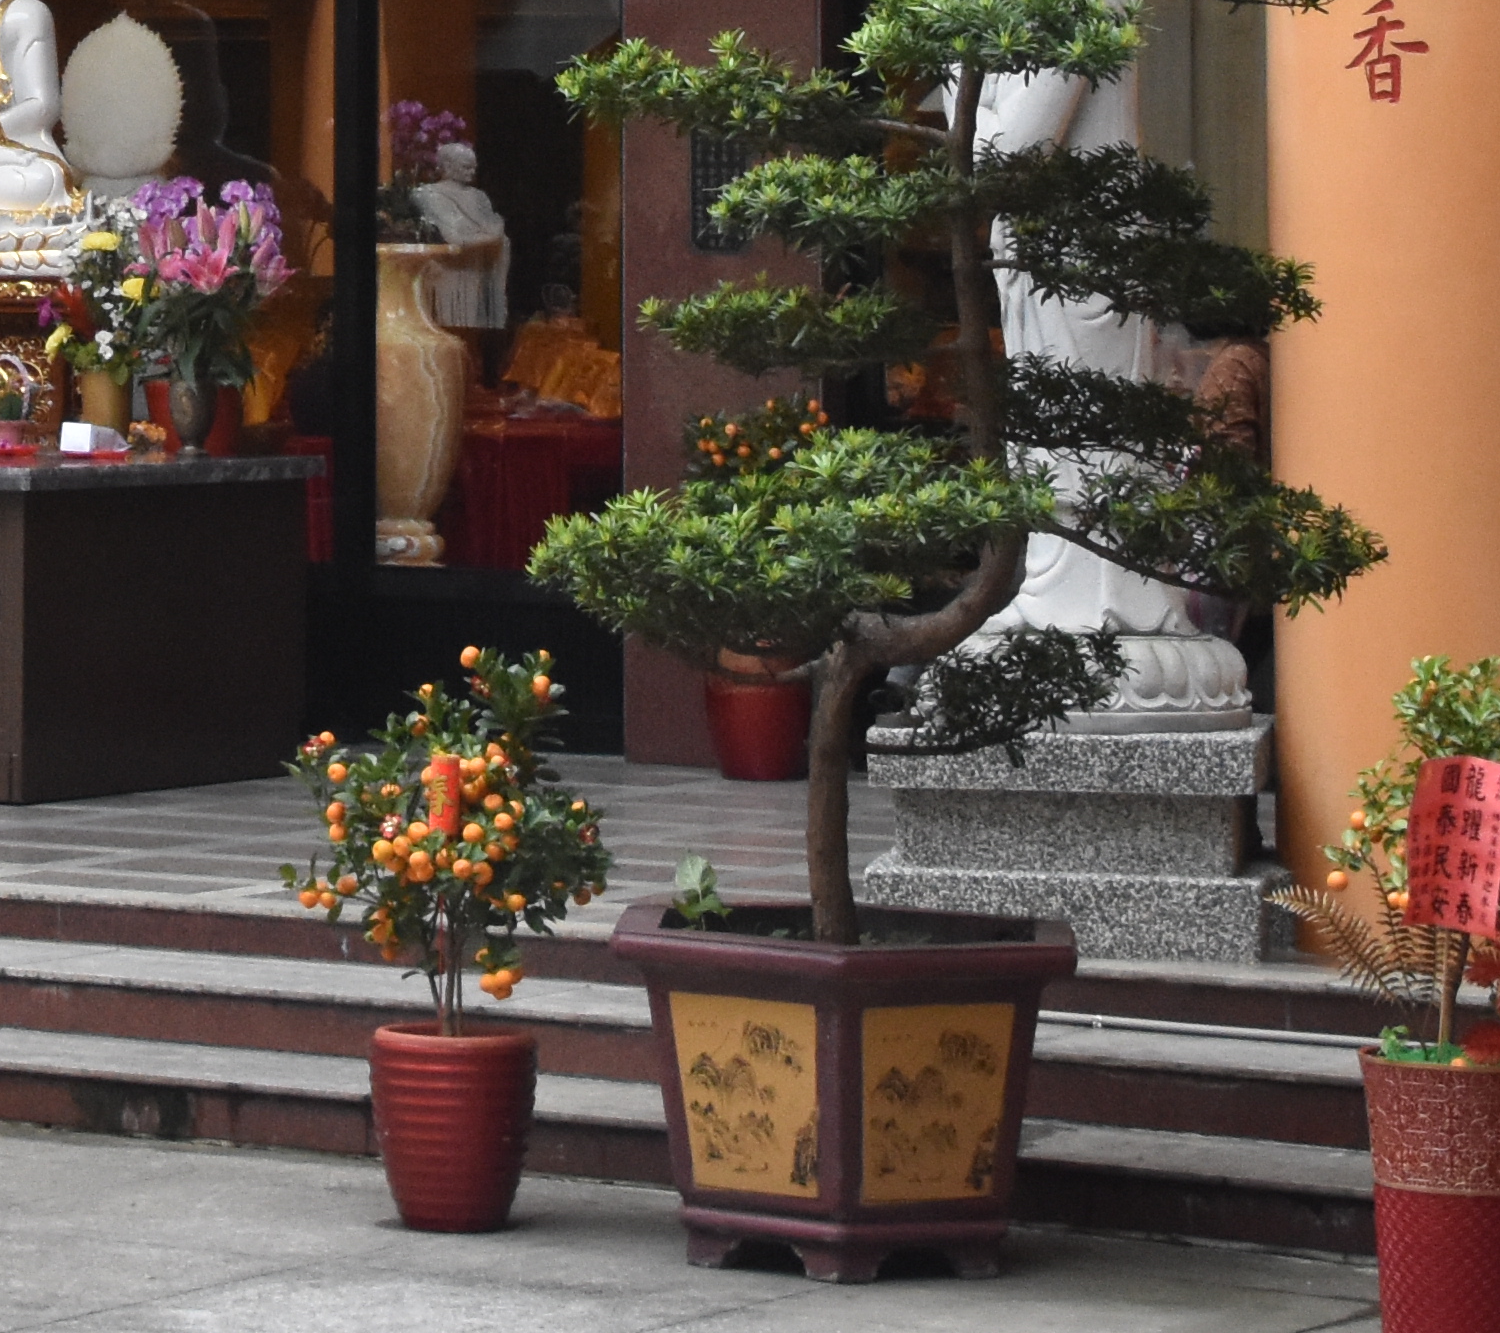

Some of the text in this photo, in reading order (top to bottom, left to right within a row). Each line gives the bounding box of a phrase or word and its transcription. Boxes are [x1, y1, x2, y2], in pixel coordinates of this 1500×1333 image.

[1431, 763, 1461, 921] 國泰民安
[1455, 763, 1487, 927] 龍躍新春
